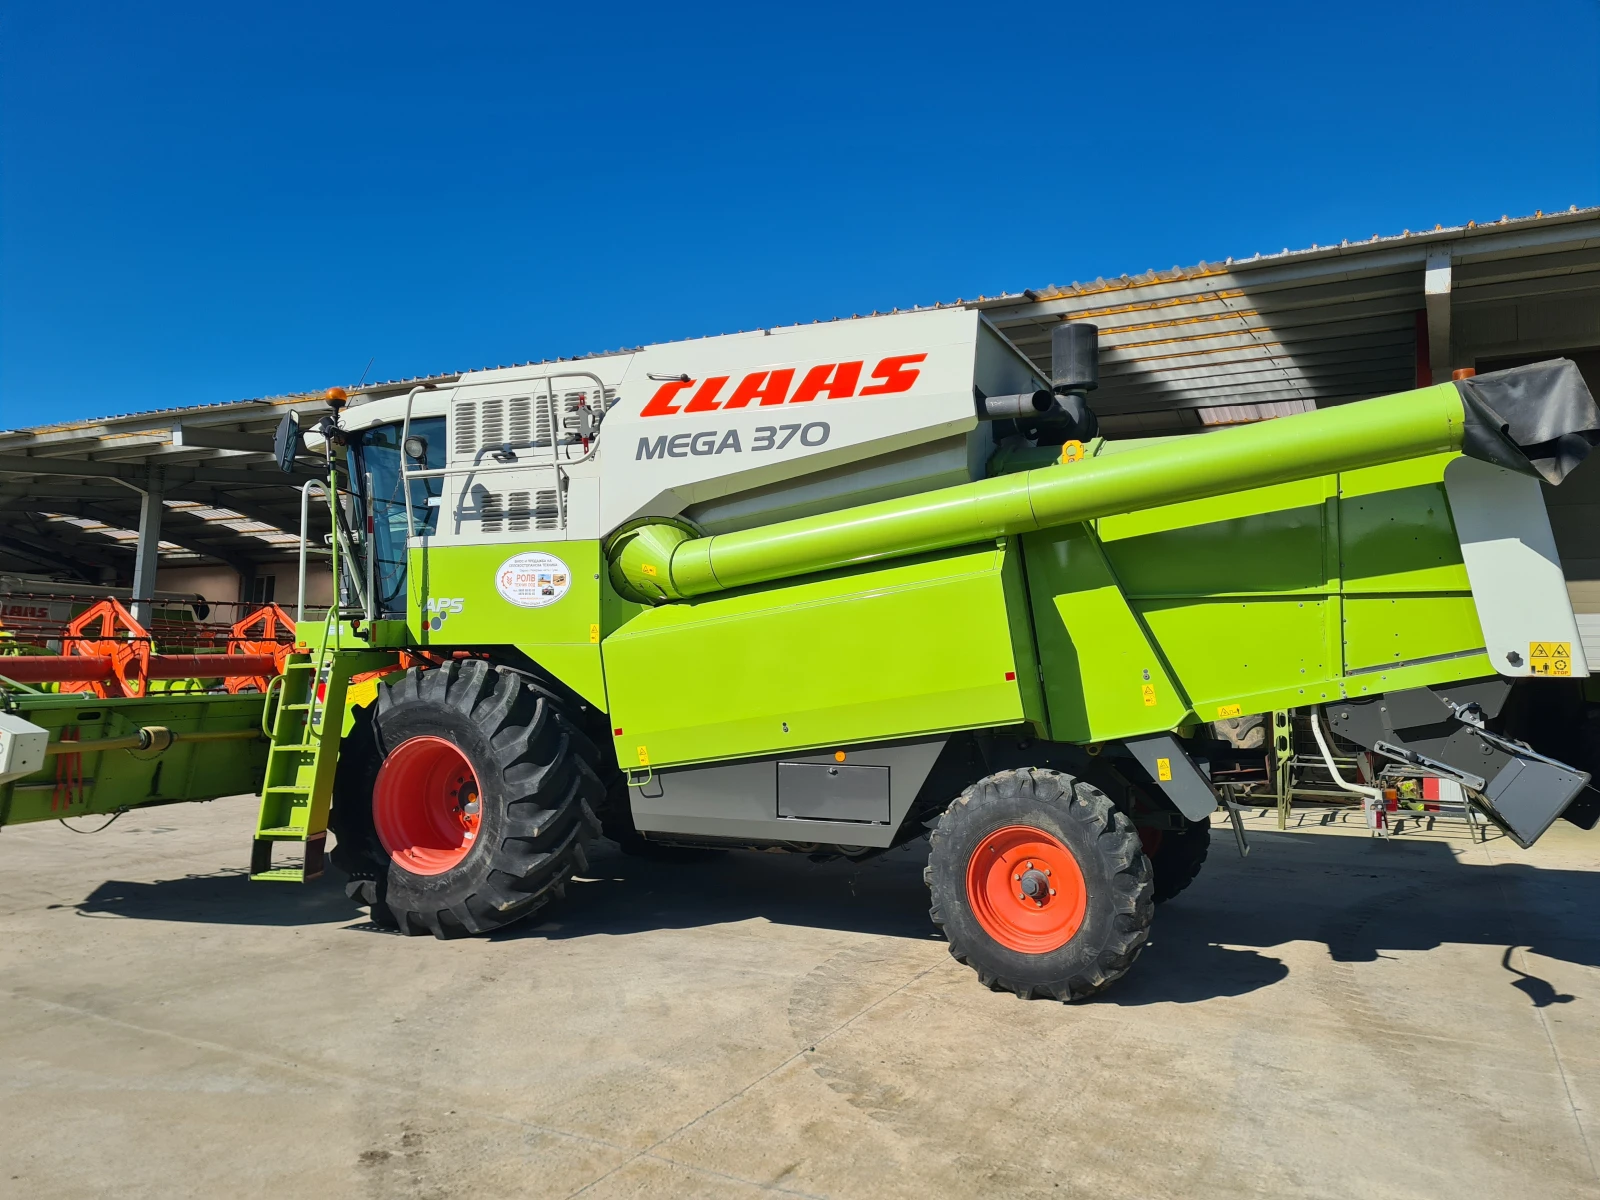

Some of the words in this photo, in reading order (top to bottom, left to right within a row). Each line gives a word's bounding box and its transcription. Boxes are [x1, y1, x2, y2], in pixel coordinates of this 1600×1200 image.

[640, 352, 928, 418] CLAAS
[635, 429, 742, 461] MEGA
[751, 421, 831, 452] 370
[516, 574, 536, 582] РОЛВ
[1, 605, 48, 618] LAAS
[422, 597, 465, 613] APS
